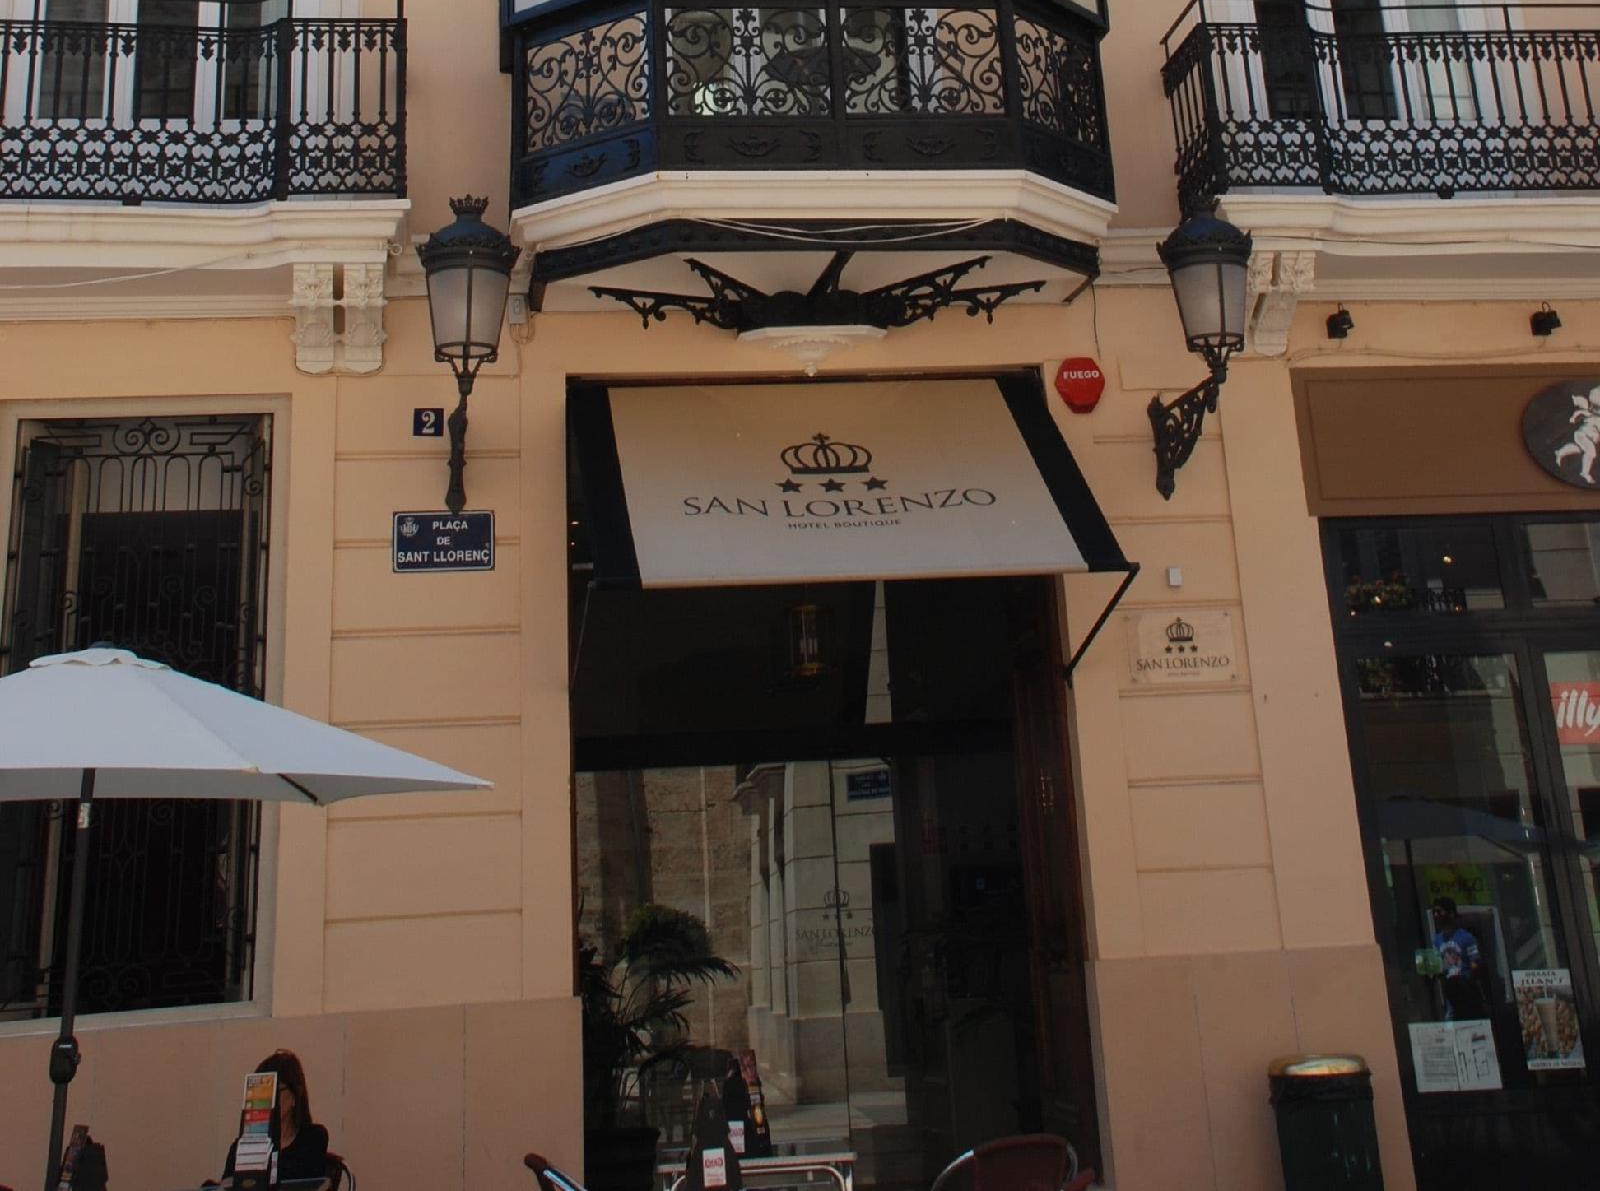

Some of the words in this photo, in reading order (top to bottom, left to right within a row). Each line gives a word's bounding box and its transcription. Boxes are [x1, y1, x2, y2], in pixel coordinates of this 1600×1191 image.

[1062, 370, 1100, 380] FUEGO
[421, 410, 436, 434] 2
[683, 496, 769, 516] SAN
[783, 488, 996, 518] LORENZO
[432, 520, 468, 532] PLAÇA
[834, 519, 901, 528] BOUTIQUE
[436, 536, 450, 546] DE
[397, 551, 430, 563] SANT
[433, 549, 490, 563] LLORENÇ
[1136, 658, 1162, 671] SAN
[1165, 656, 1230, 669] LORENZO
[1556, 688, 1600, 735] illy
